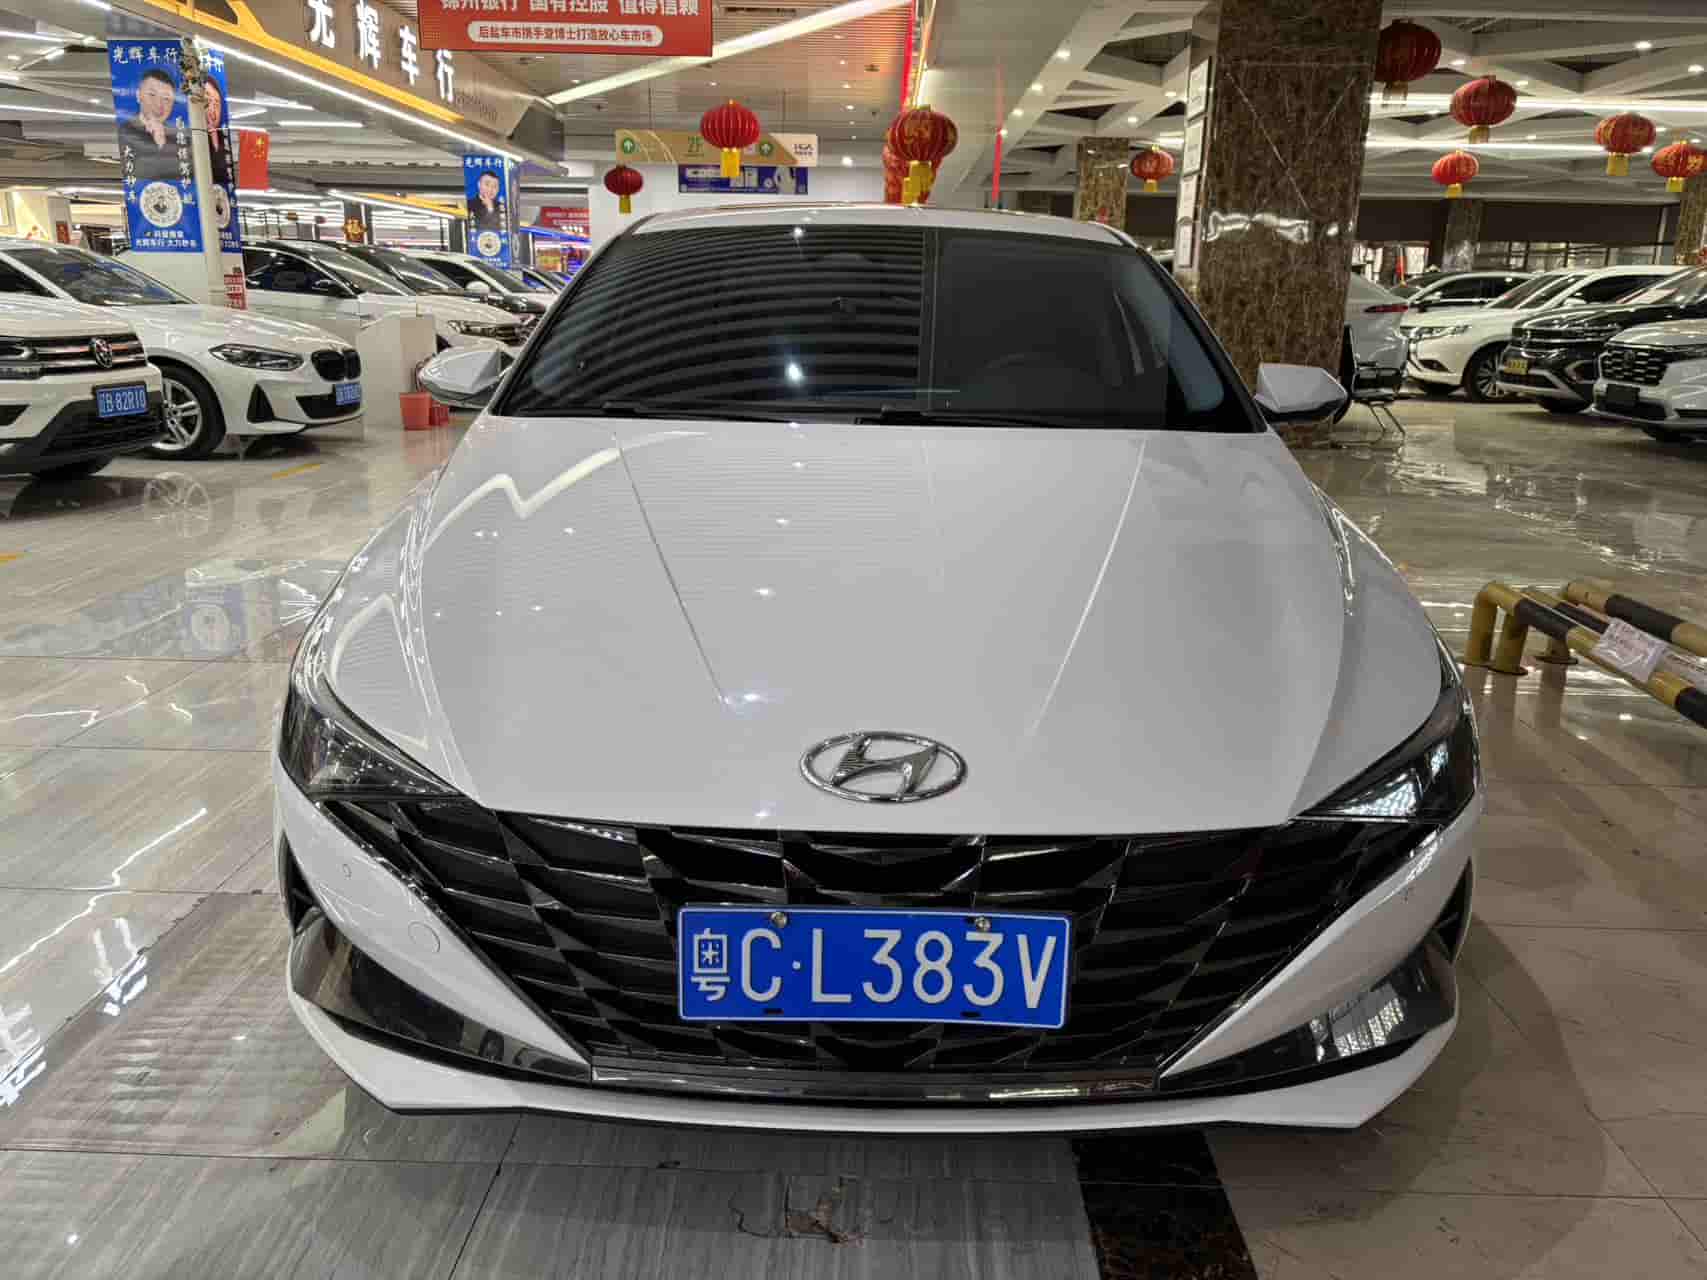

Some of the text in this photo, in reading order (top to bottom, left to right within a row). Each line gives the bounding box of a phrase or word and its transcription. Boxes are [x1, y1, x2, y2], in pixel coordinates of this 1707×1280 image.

[112, 45, 179, 64] 光辉车行
[690, 927, 1057, 1009] 粤C·L383V
